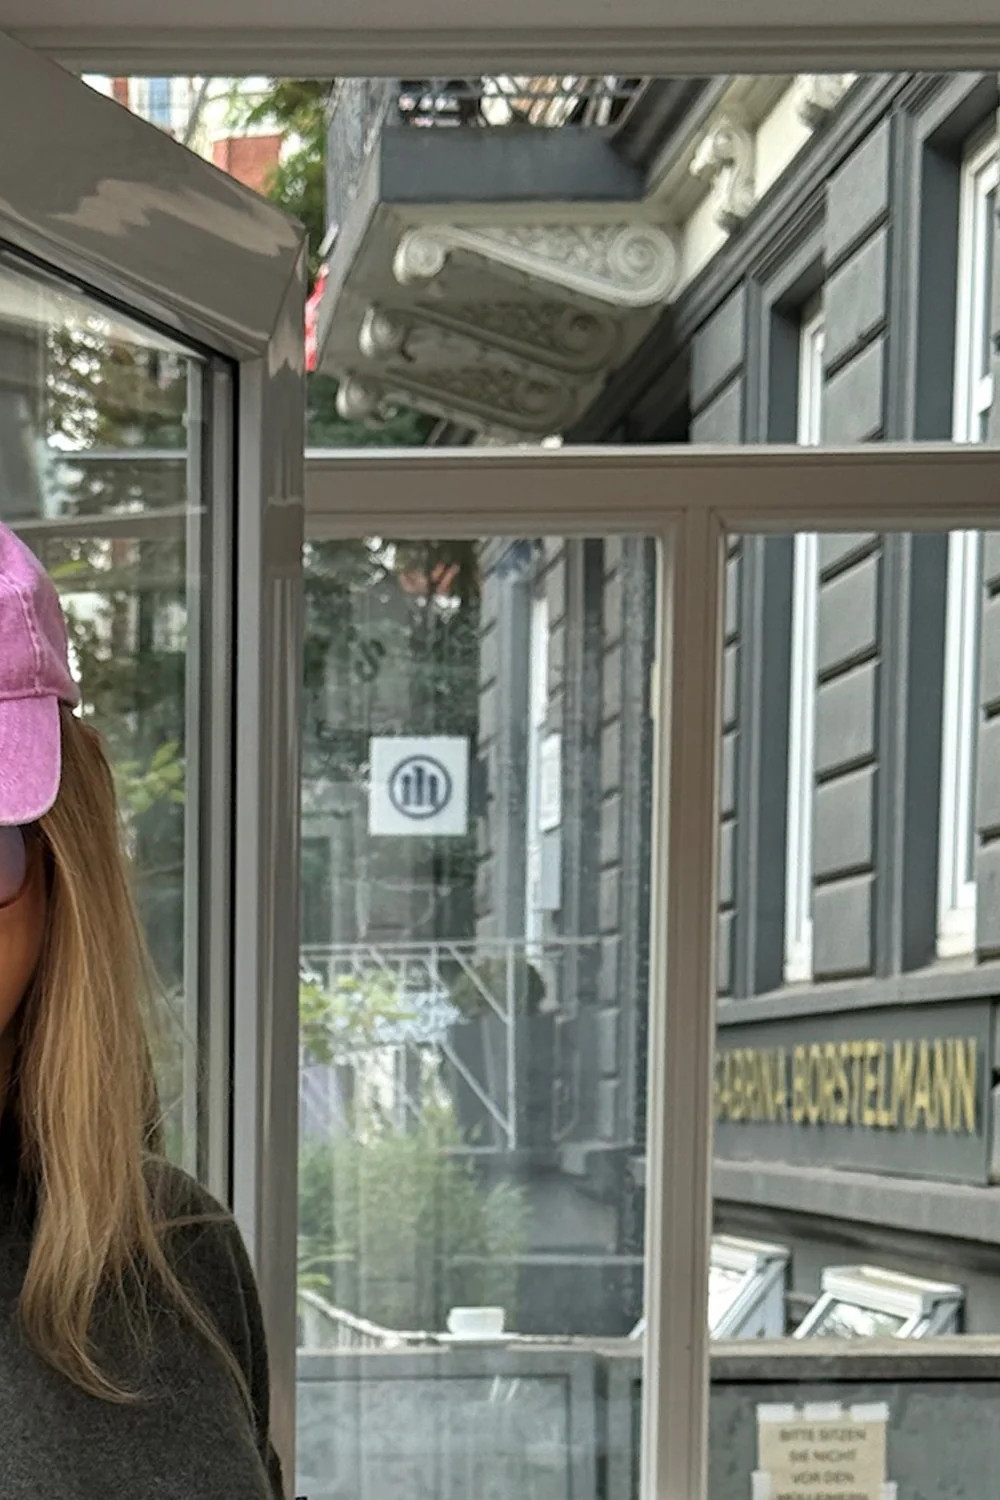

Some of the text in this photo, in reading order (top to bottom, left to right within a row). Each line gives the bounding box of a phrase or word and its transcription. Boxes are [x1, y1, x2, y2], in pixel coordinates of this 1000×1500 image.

[793, 1038, 976, 1132] BORSTELMANN
[780, 1428, 814, 1442] BITTE
[789, 1449, 857, 1462] SIE NICHT
[792, 1471, 855, 1484] VOR DEN
